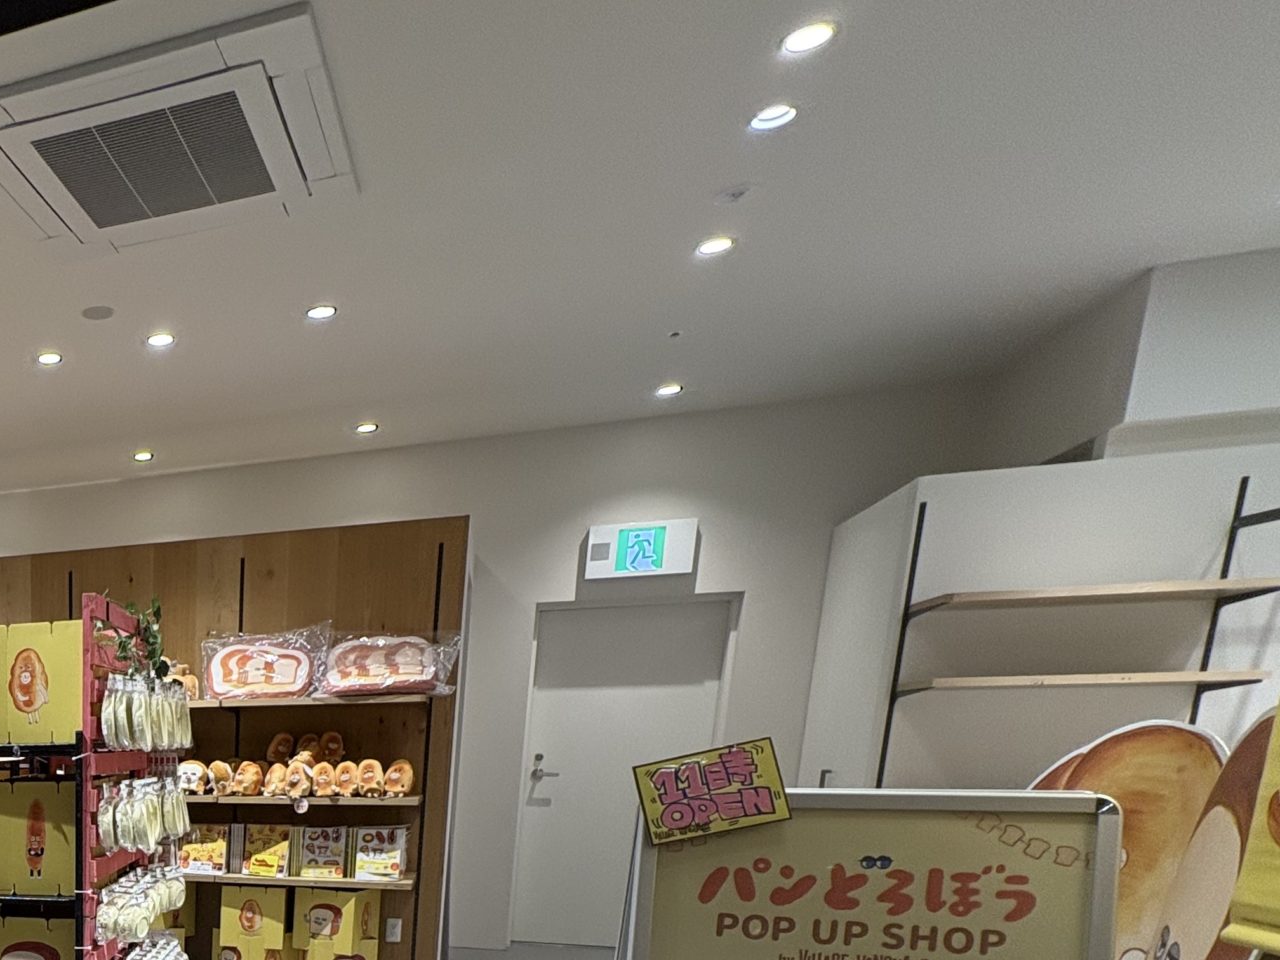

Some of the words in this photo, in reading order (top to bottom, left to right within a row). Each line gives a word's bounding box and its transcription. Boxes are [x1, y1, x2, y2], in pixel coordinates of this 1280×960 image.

[650, 746, 758, 805] 11時
[660, 787, 776, 829] OPEN
[698, 856, 1037, 922] パンどろぼう
[715, 912, 796, 941] POP
[812, 918, 869, 946] UP
[881, 922, 1007, 955] SHOP
